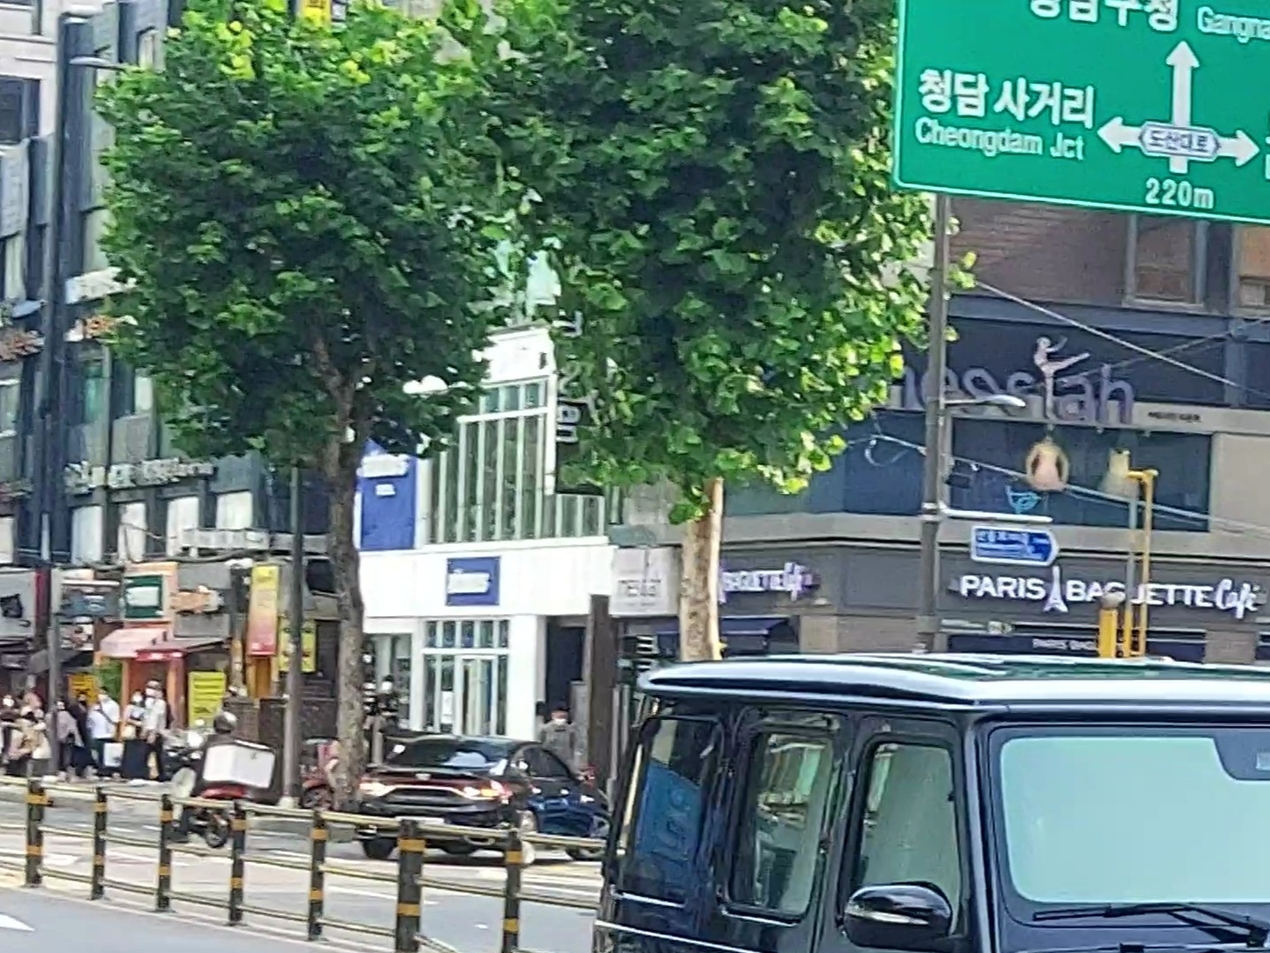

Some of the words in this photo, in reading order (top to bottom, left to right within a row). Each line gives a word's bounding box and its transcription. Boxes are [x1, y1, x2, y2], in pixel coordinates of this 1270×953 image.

[917, 68, 990, 118] 청담
[993, 77, 1095, 130] 사거리
[915, 116, 1044, 158] Cheongdam
[1050, 131, 1084, 161] Jct
[1145, 177, 1215, 209] 220m
[960, 574, 1047, 601] PARIS
